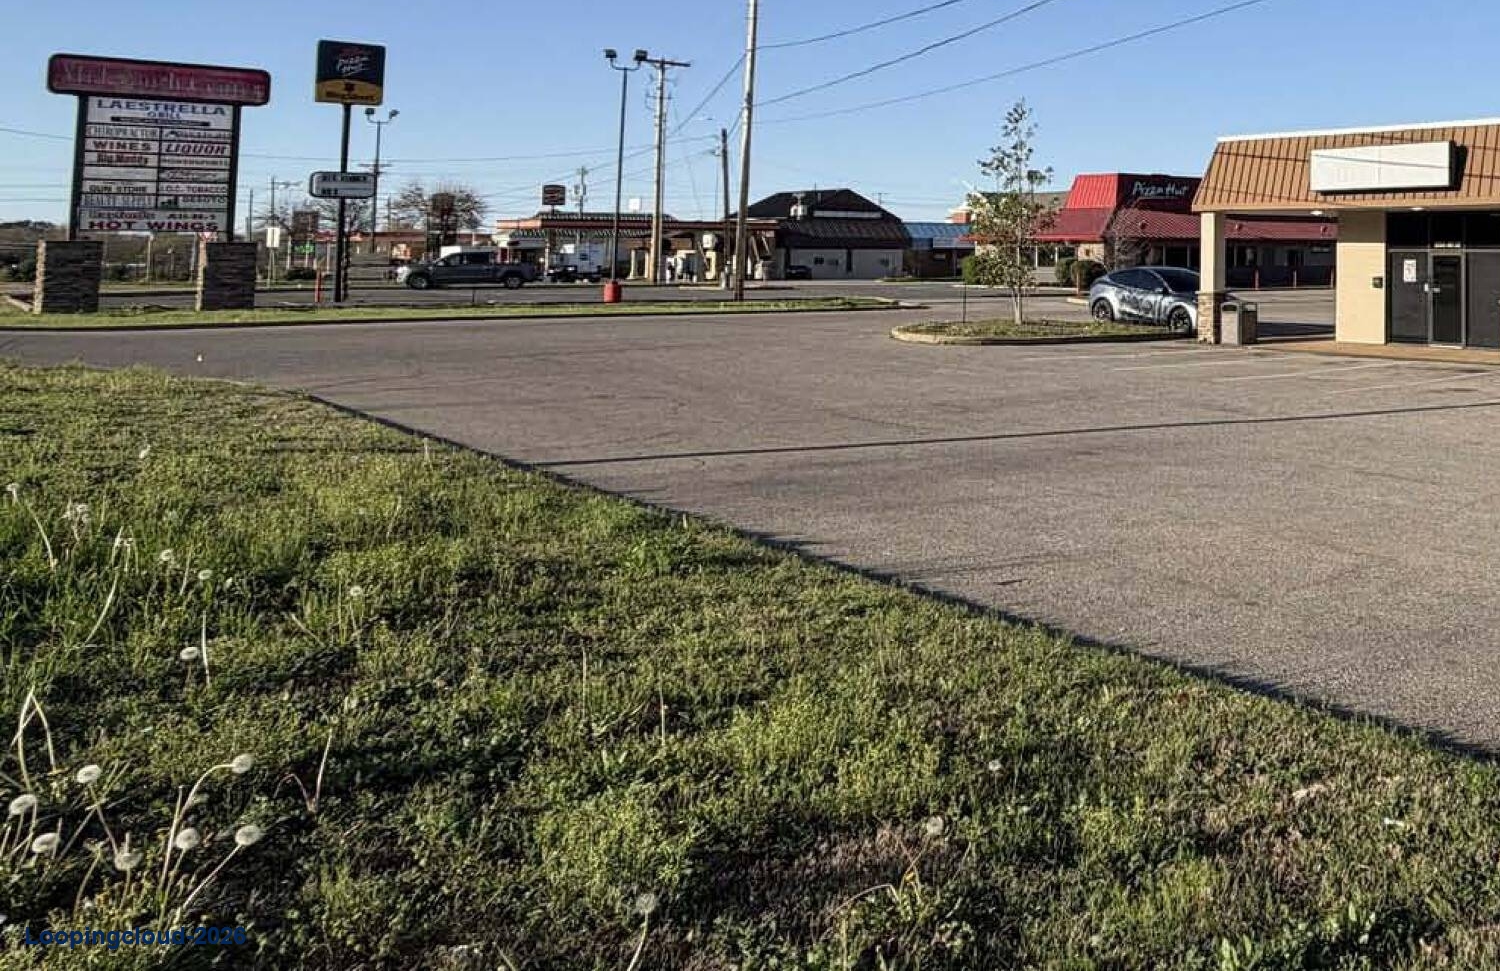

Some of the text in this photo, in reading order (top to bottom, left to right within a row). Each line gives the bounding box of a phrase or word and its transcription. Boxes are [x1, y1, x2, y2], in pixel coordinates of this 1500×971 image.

[93, 140, 152, 151] WINES
[165, 143, 227, 155] LIQUOR
[1132, 180, 1190, 197] Pizza Hut
[88, 220, 220, 232] HOT WINGS
